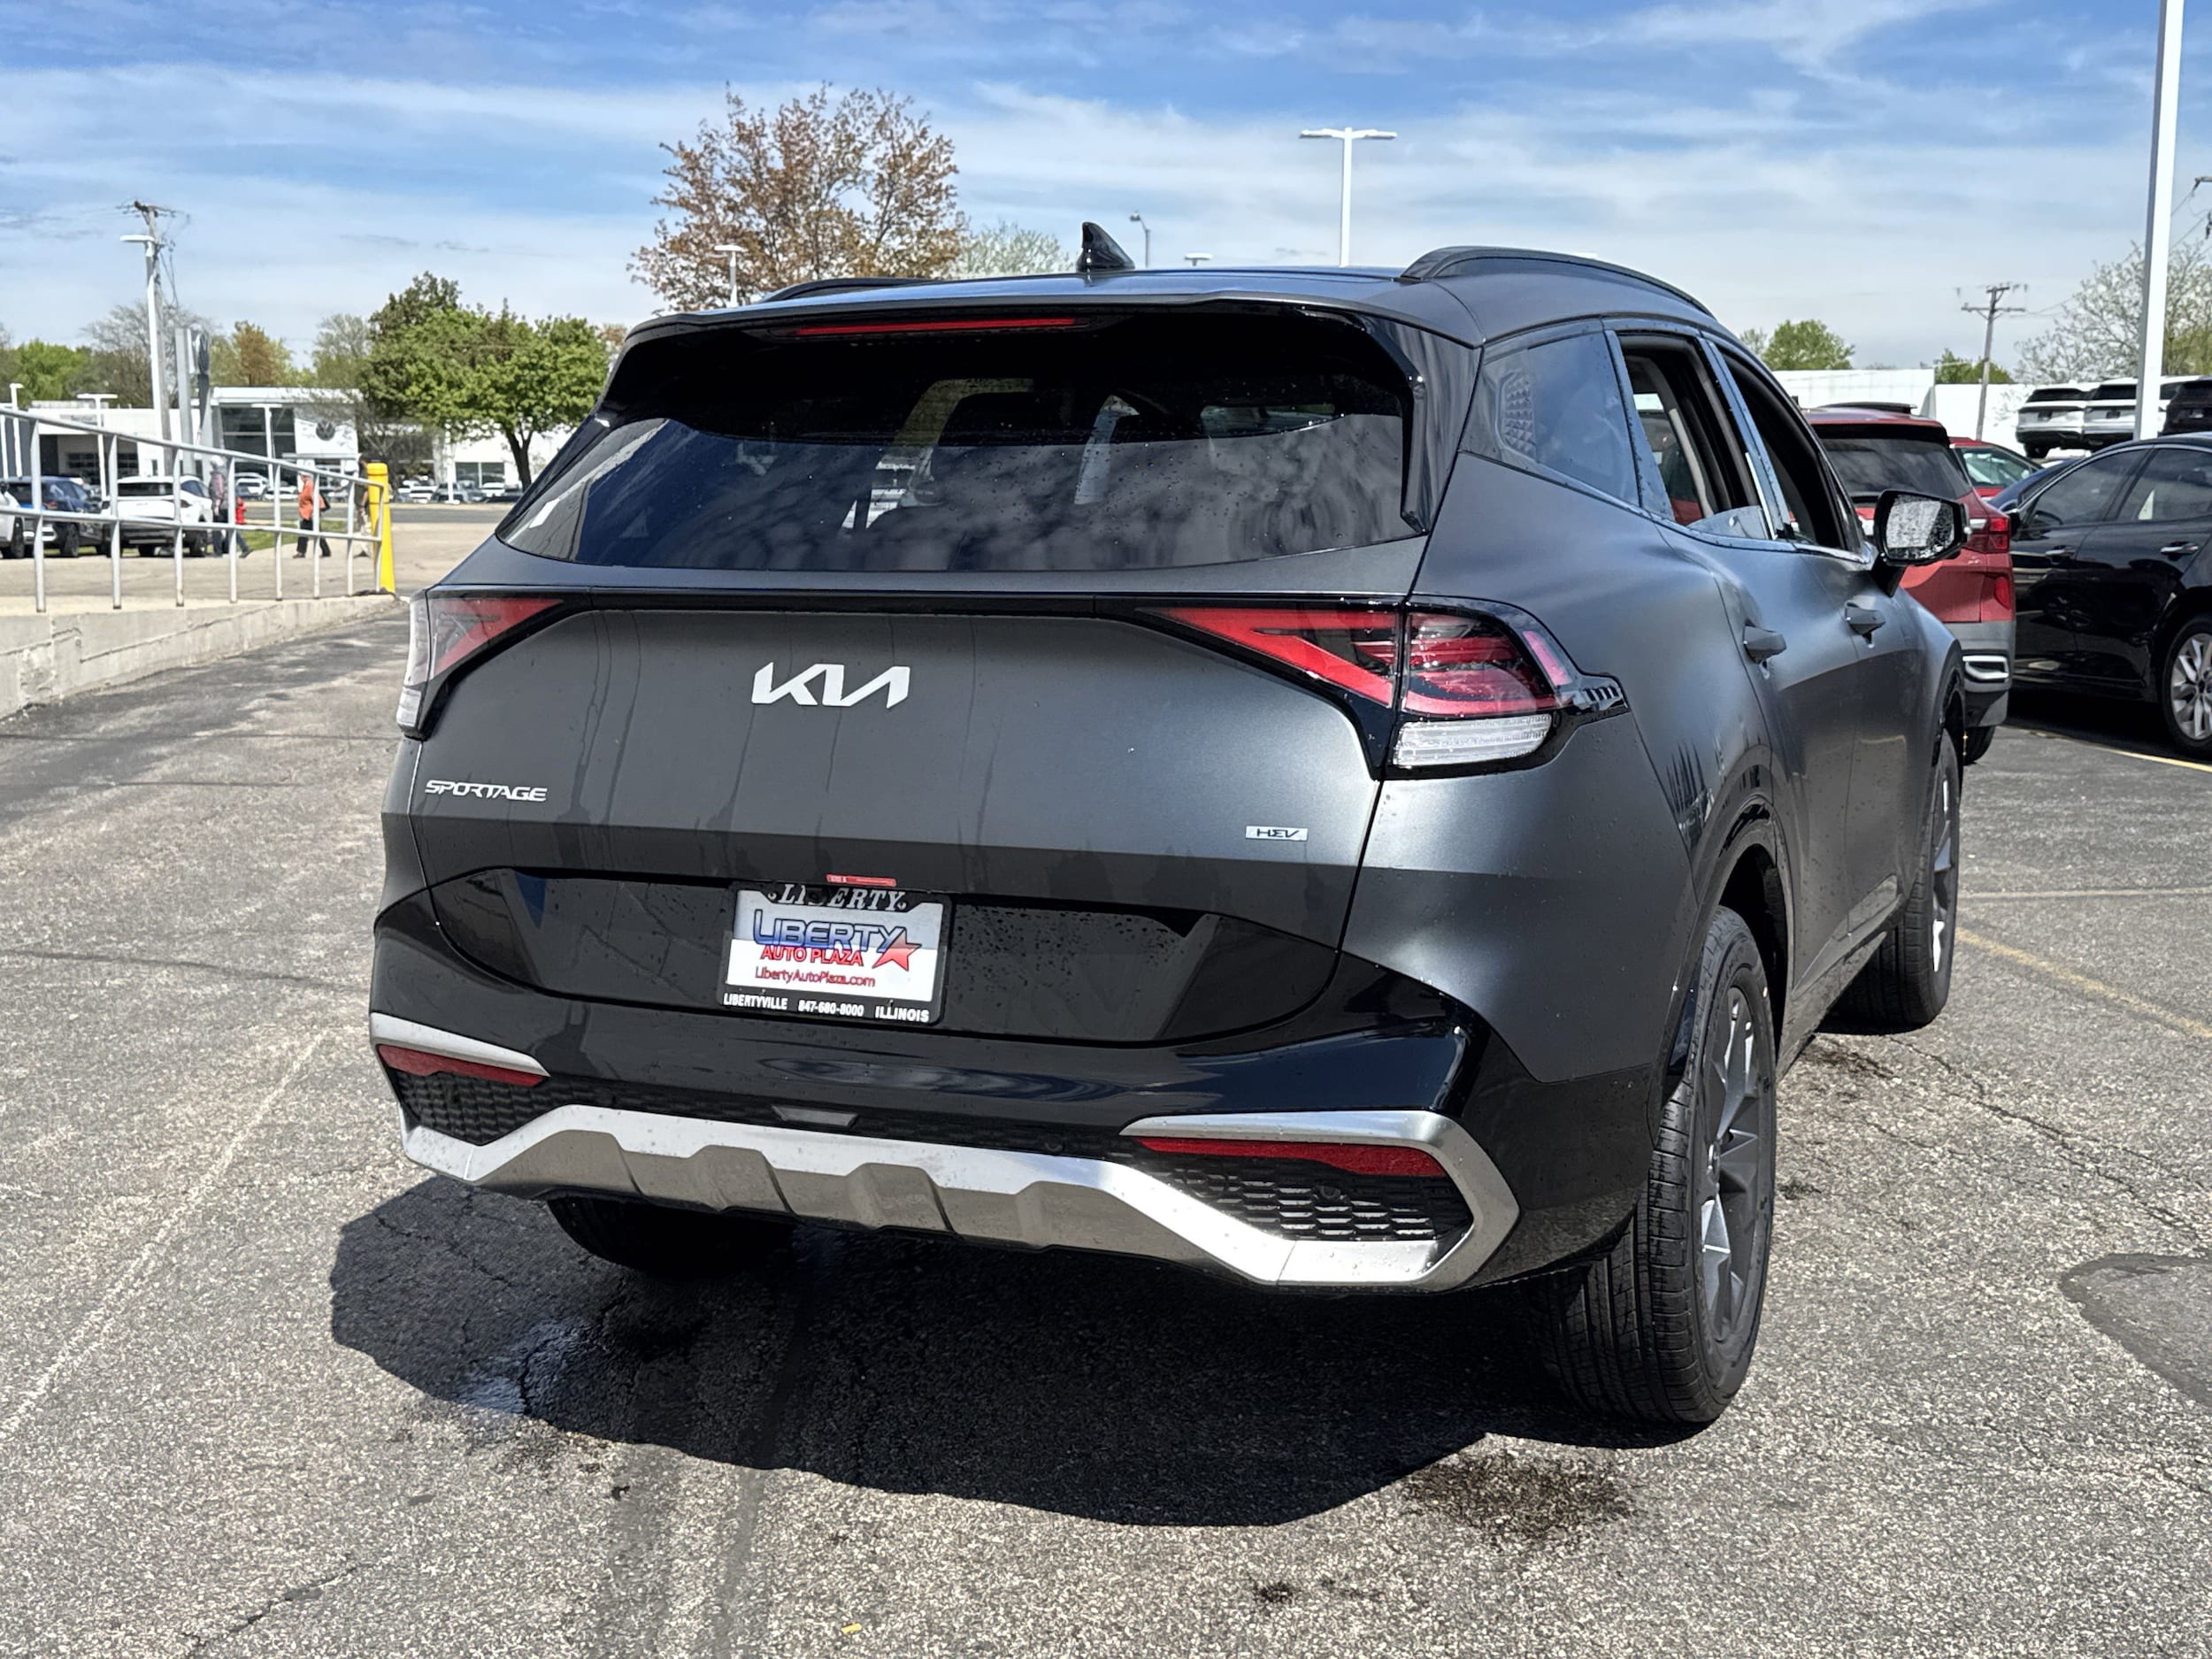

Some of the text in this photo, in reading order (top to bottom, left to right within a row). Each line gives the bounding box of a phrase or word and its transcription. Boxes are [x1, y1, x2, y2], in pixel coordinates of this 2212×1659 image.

[752, 662, 910, 709] KIA
[425, 780, 548, 802] SPORTAGE
[1256, 828, 1300, 838] HEV
[778, 884, 906, 911] LIERTY
[753, 909, 904, 953] LIBERTY
[760, 945, 864, 966] AUTO PLAZA
[755, 966, 876, 987] LibertyAutoPlaza.com
[723, 993, 930, 1023] LIBERTYVILLE 847-680-8000 ILLINOIS
